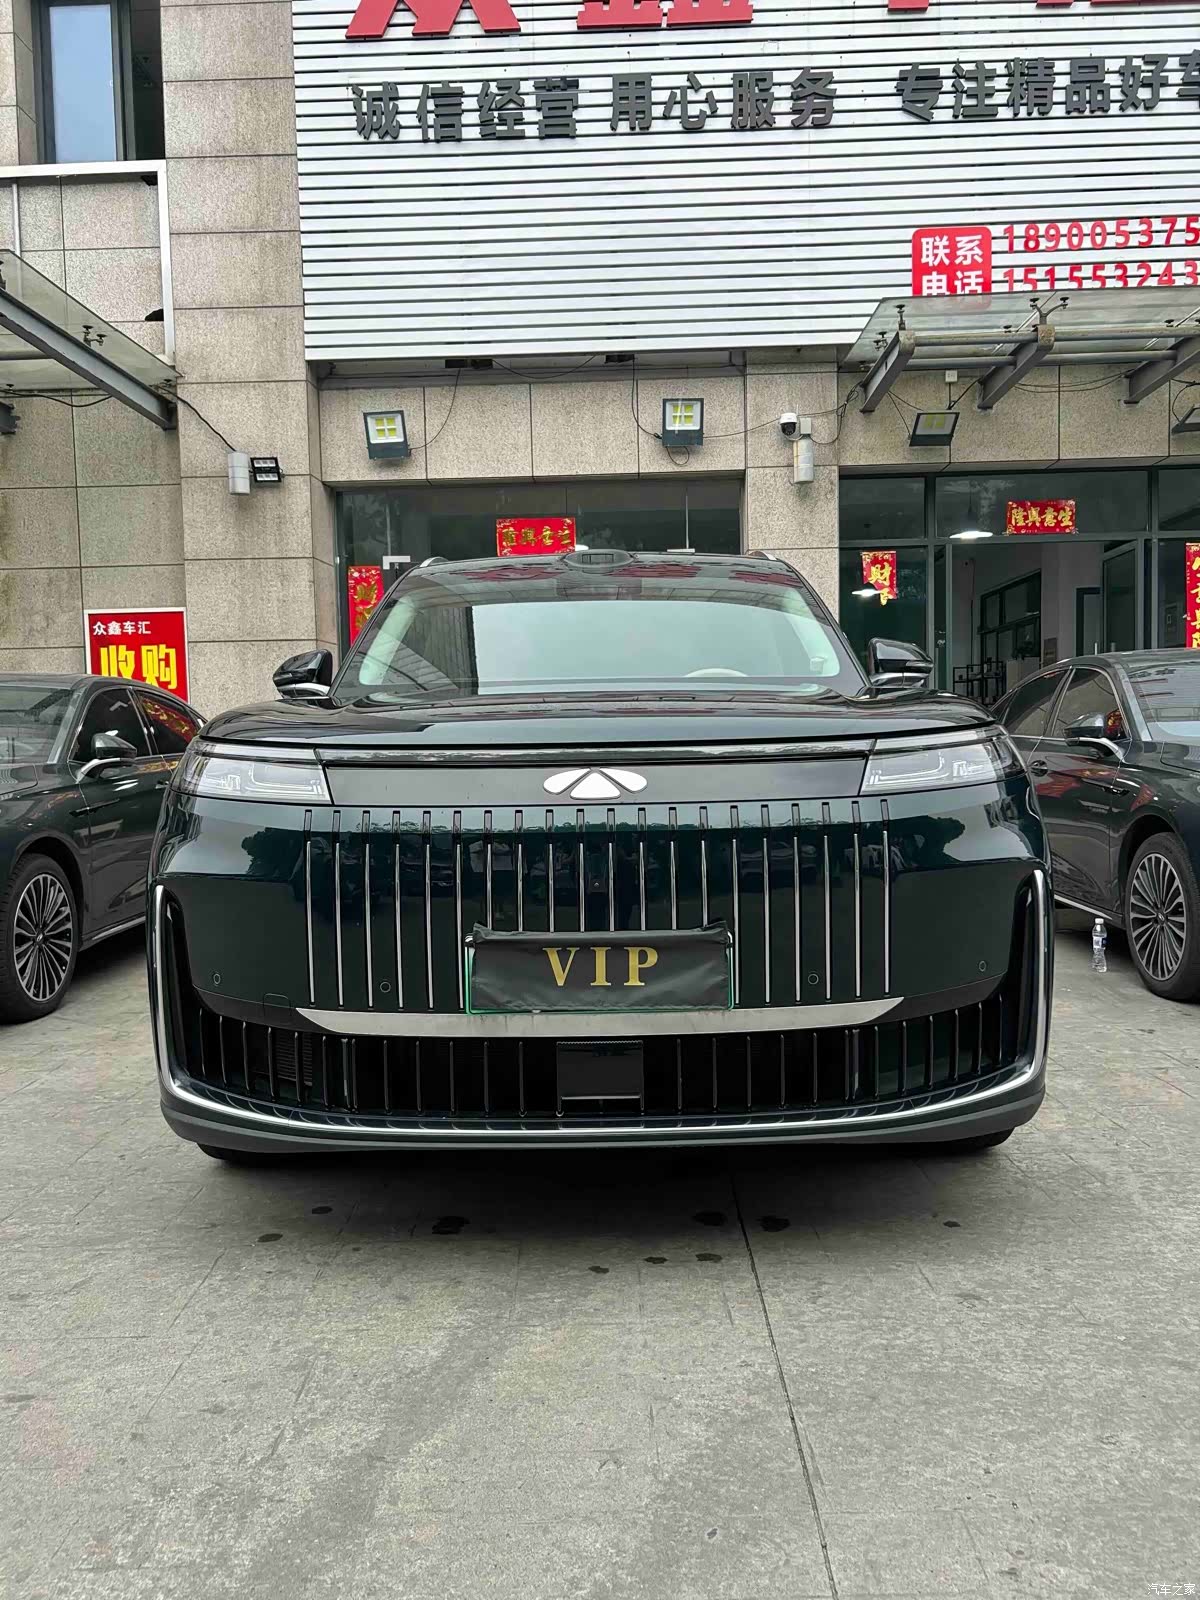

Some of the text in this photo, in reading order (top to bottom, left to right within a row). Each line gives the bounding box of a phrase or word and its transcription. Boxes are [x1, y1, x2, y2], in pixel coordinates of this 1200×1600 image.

[352, 77, 580, 143] 诚信经营
[610, 68, 837, 131] 用心服务
[921, 235, 983, 267] 联系
[1003, 216, 1200, 254] 189005375
[922, 271, 984, 296] 电话
[1003, 260, 1199, 292] 151553243
[93, 621, 151, 635] 众鑫车汇
[100, 644, 178, 689] 收购
[542, 947, 658, 986] VIP
